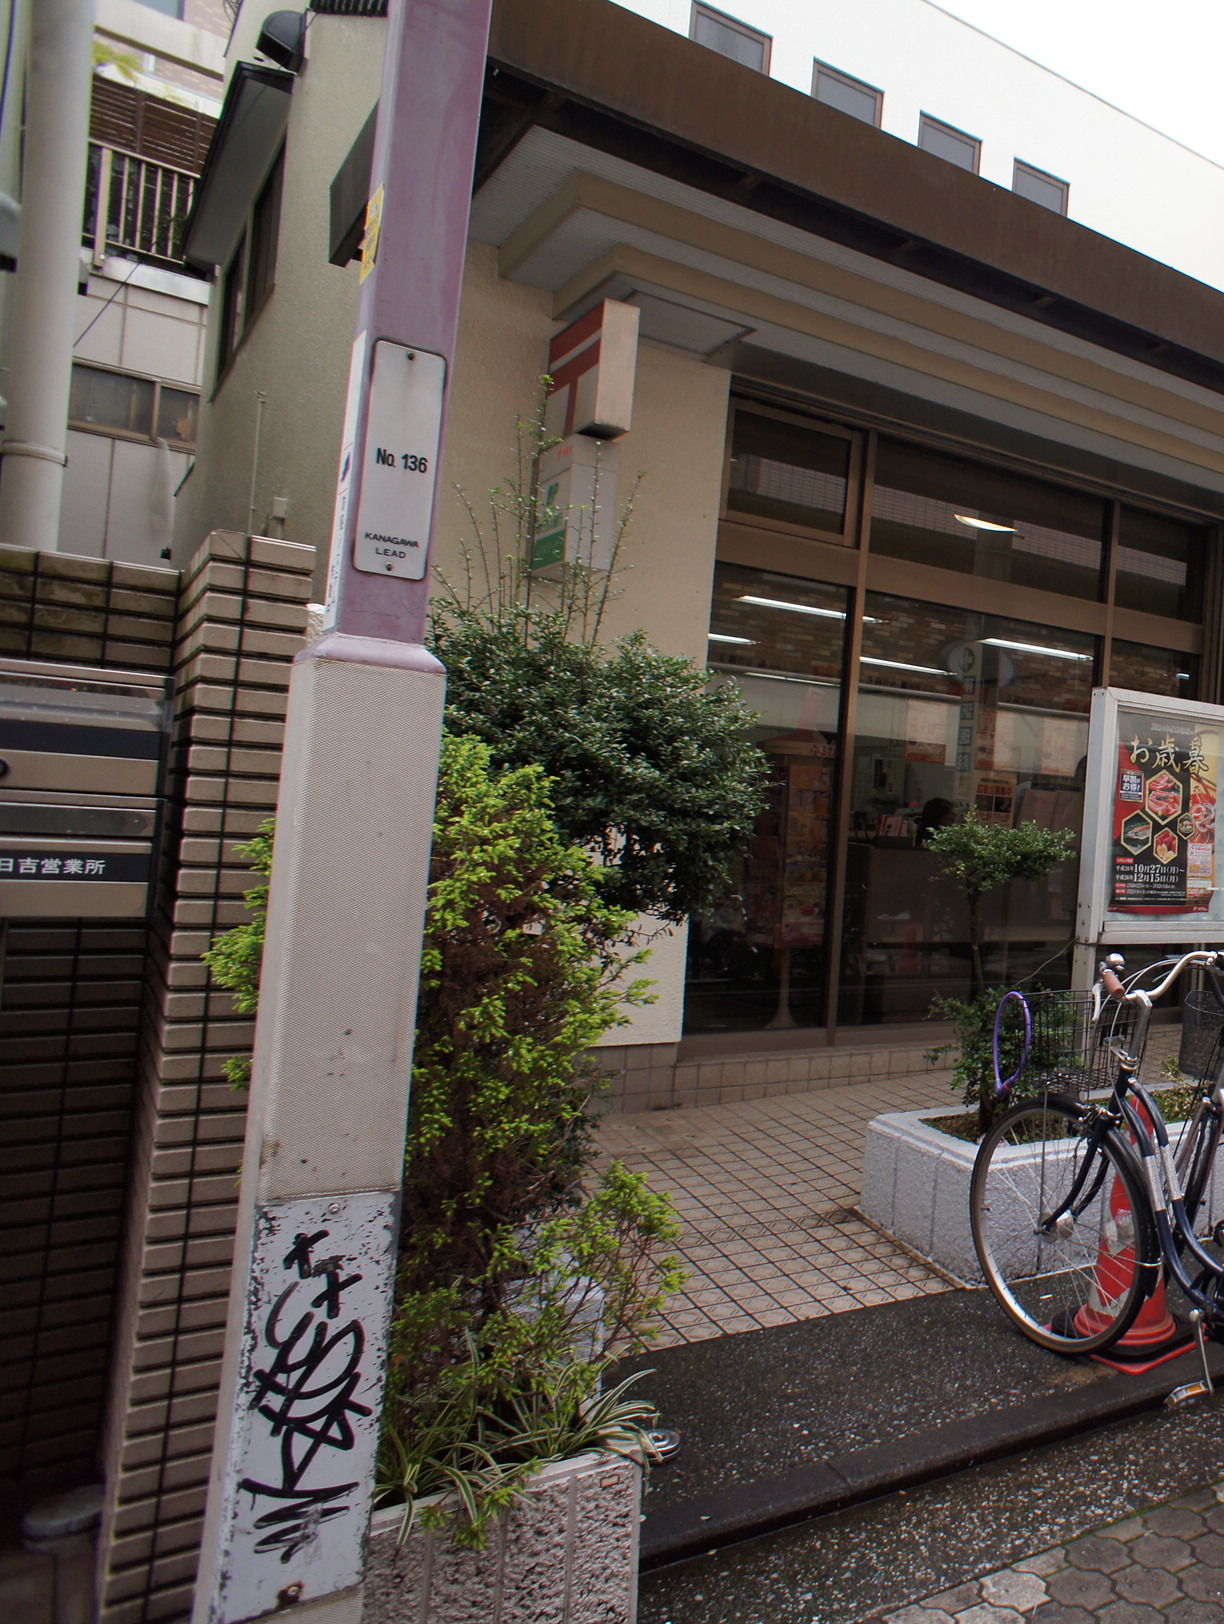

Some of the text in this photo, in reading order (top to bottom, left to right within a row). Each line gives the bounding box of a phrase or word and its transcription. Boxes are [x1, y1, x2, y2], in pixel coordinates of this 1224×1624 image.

[401, 453, 427, 473] 136
[364, 532, 419, 548] KANAGAWA
[375, 547, 407, 559] LEAD
[1130, 734, 1210, 776] お歳暮
[0, 857, 106, 875] 日吉営業所
